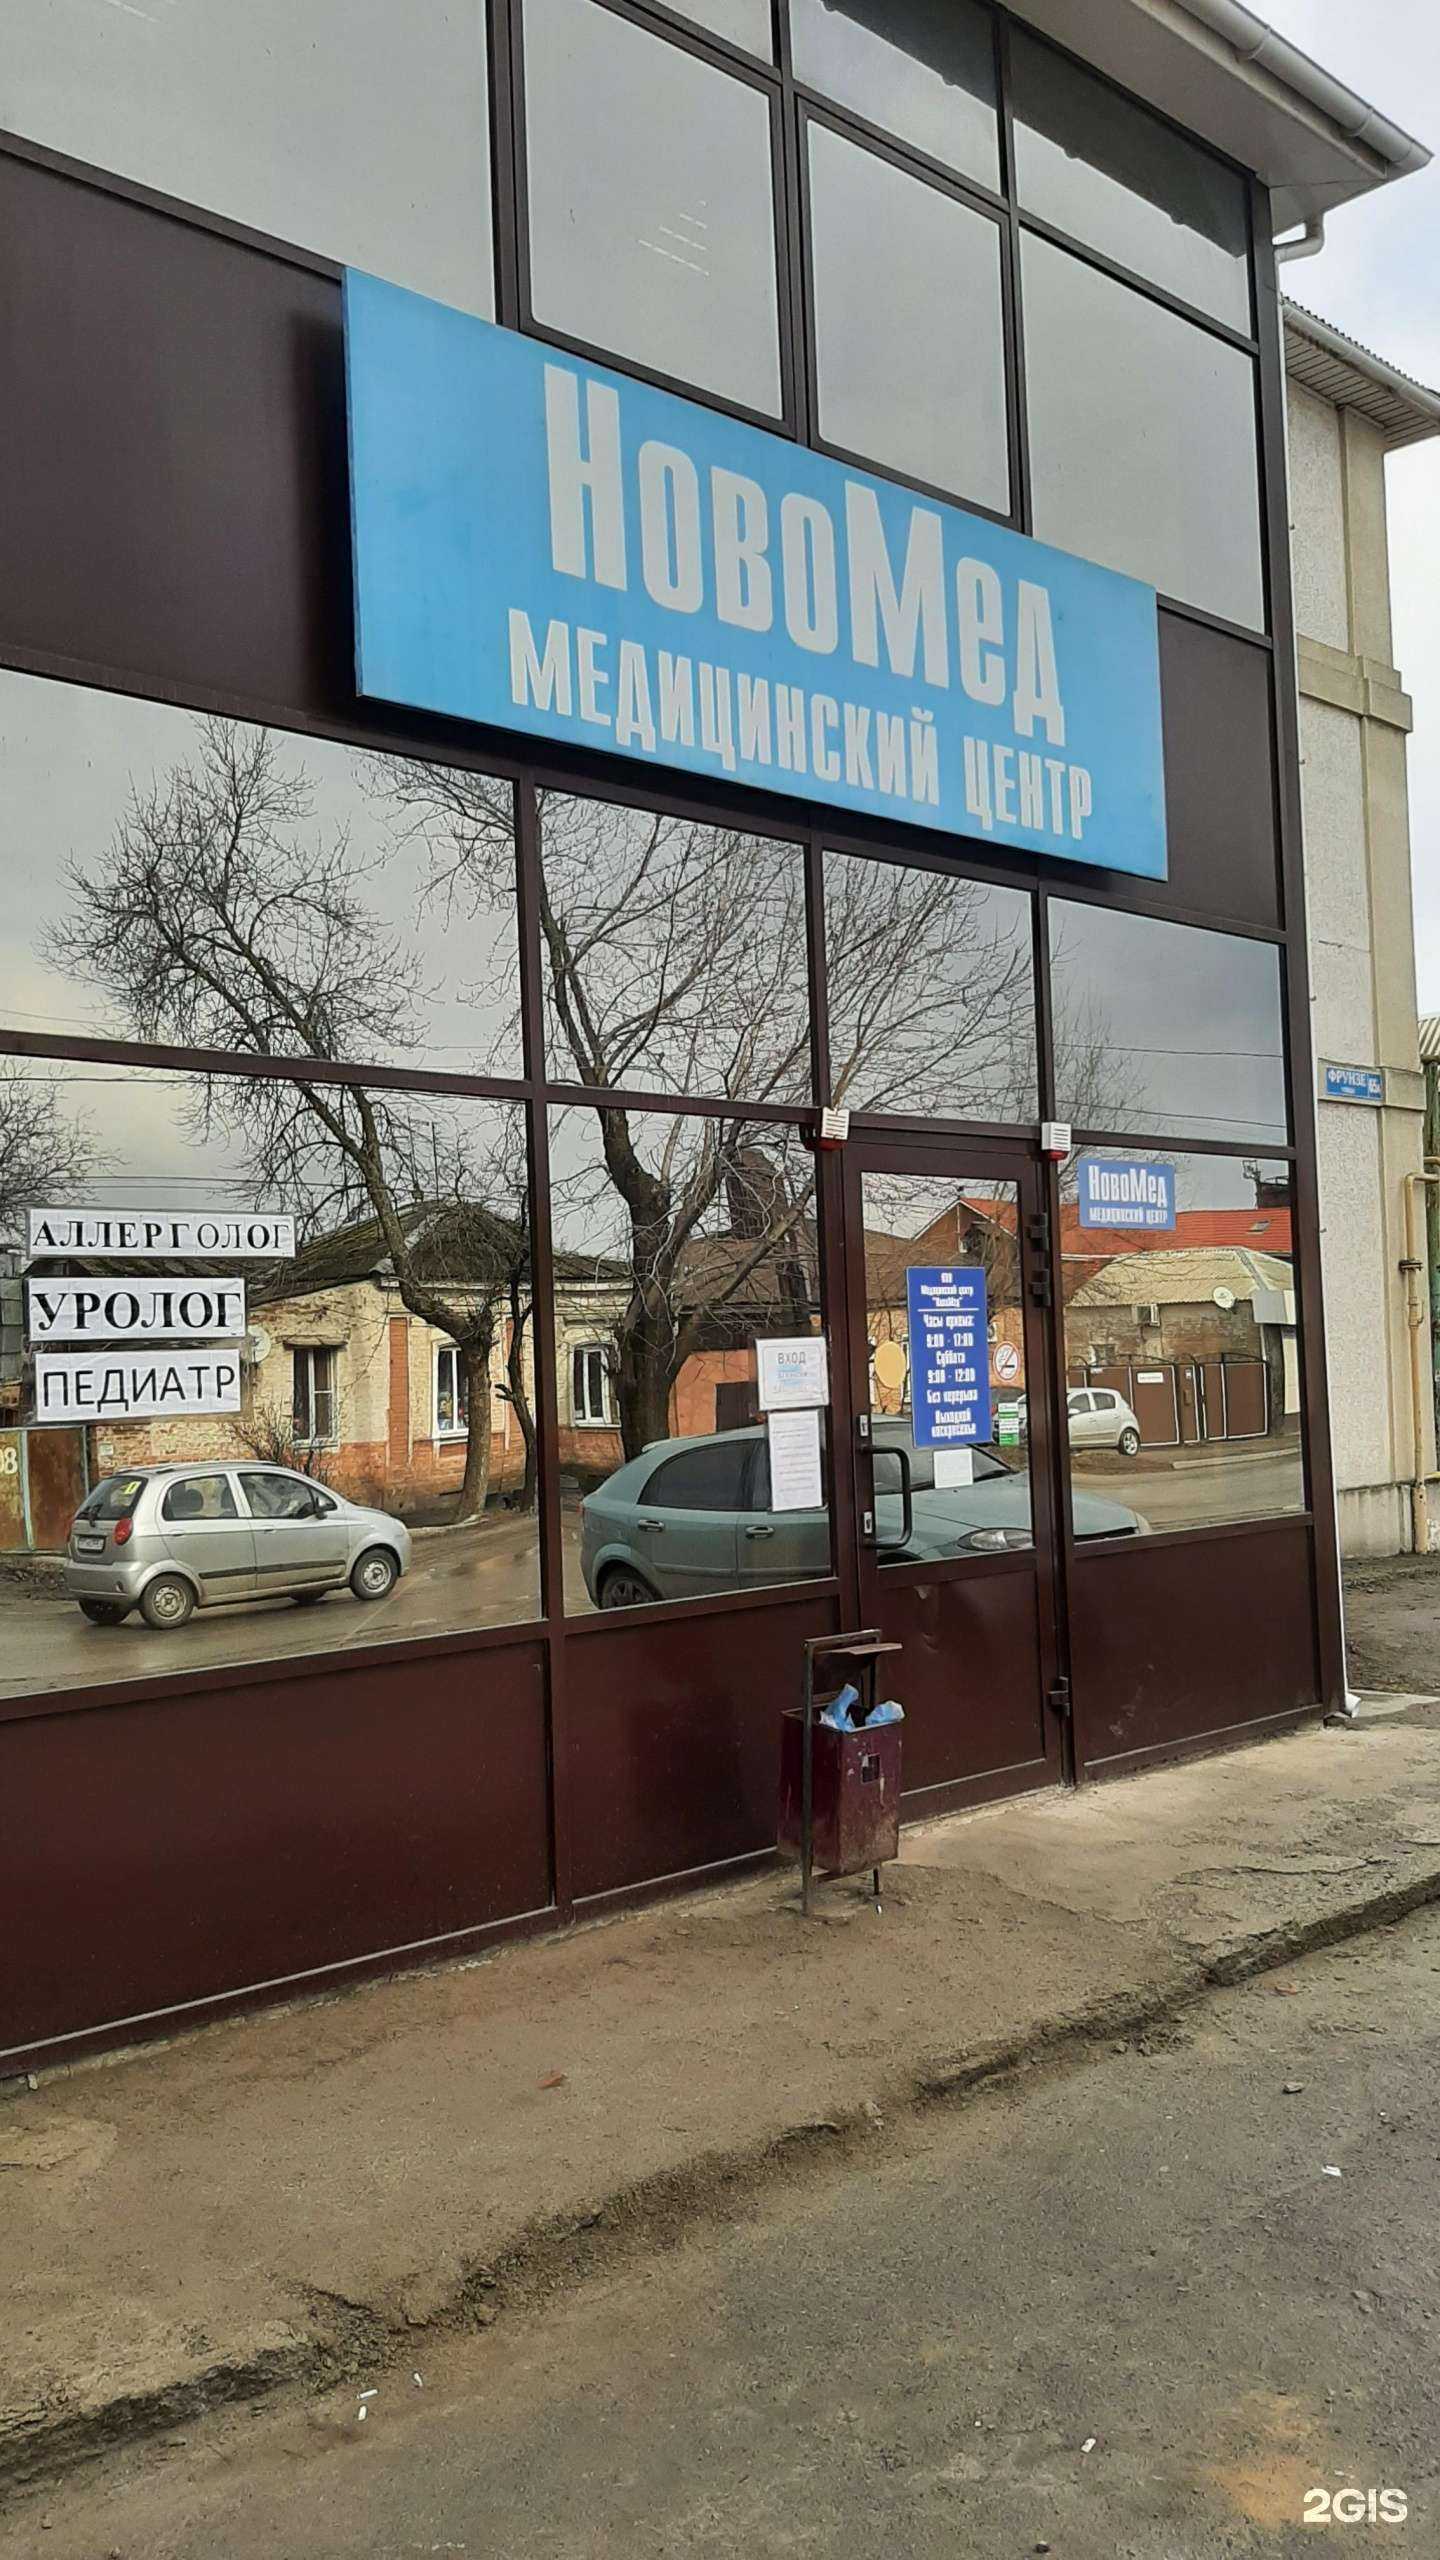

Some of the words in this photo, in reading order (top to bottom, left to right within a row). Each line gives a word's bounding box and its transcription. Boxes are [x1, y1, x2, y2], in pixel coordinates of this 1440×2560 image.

[508, 607, 939, 807] МЕДИЦИНСКИЙ
[963, 735, 1092, 840] ЦЕНТР
[1328, 1069, 1367, 1087] ФРУНЗЕ
[33, 1220, 290, 1250] АЛЛЕРГОЛОГ
[32, 1292, 241, 1331] УРОЛОГ
[953, 1332, 974, 1347] 17:00
[777, 1351, 807, 1365] ВХОД
[927, 1369, 946, 1384] 9:00
[954, 1367, 976, 1383] 12:00
[43, 1365, 235, 1413] ПЕДИАТР
